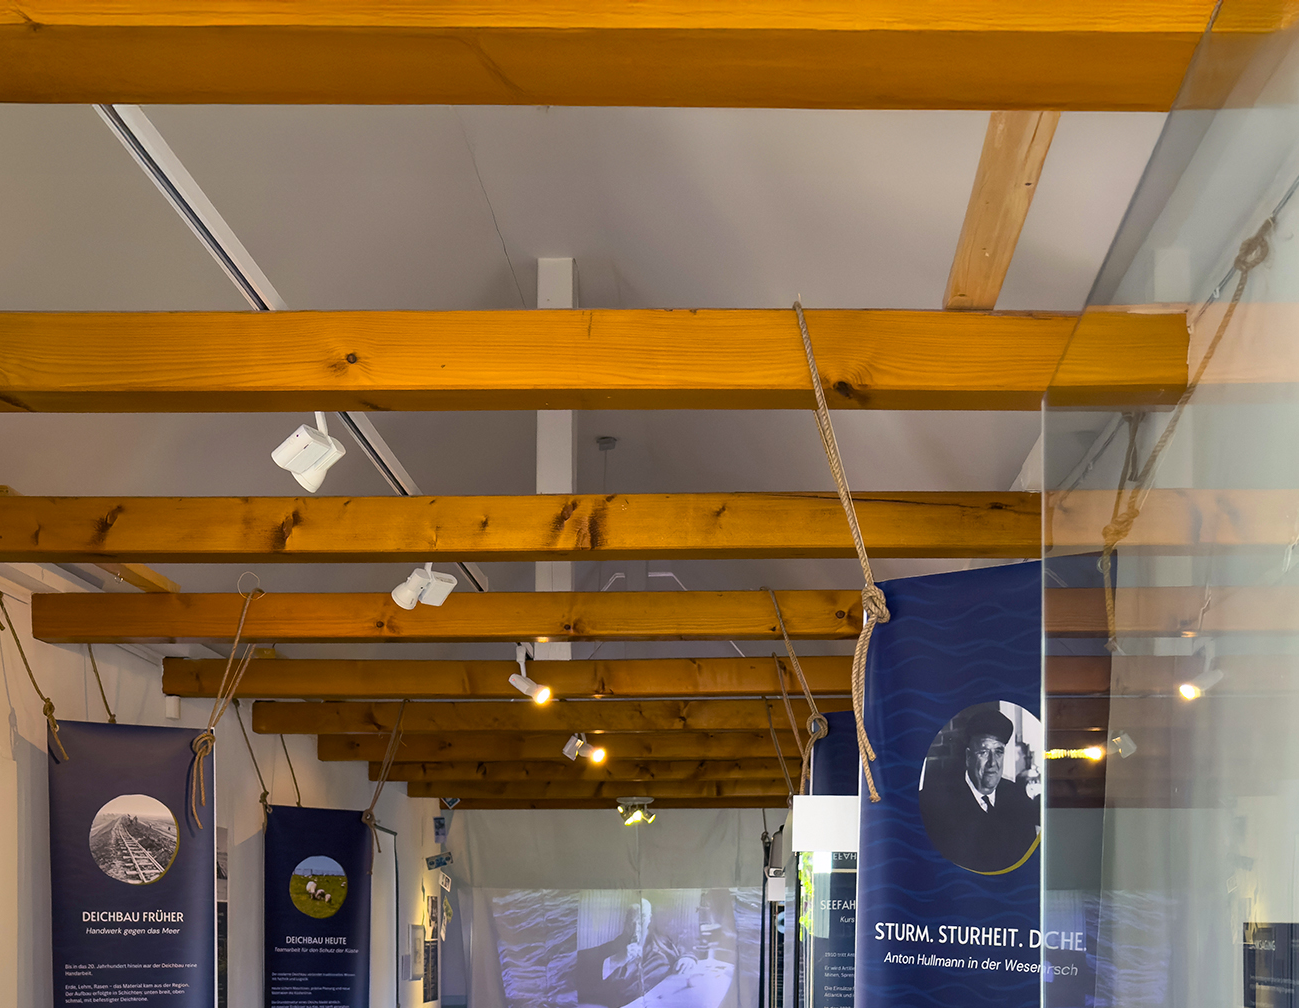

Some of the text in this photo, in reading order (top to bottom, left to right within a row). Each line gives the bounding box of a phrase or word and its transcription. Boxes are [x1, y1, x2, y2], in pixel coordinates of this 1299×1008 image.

[820, 900, 856, 910] SEEFAH
[82, 909, 184, 922] DEICHBAU FRÜHER
[85, 927, 122, 935] Handwerk
[123, 928, 145, 936] gegen
[147, 927, 160, 935] das
[874, 922, 1087, 951] STURM. STURHEIT. DCHE.
[285, 936, 347, 945] DEICHBAU HEUTE
[884, 951, 915, 965] Anton
[917, 953, 965, 969] Hullmann
[967, 957, 978, 969] in
[981, 958, 1001, 970] der
